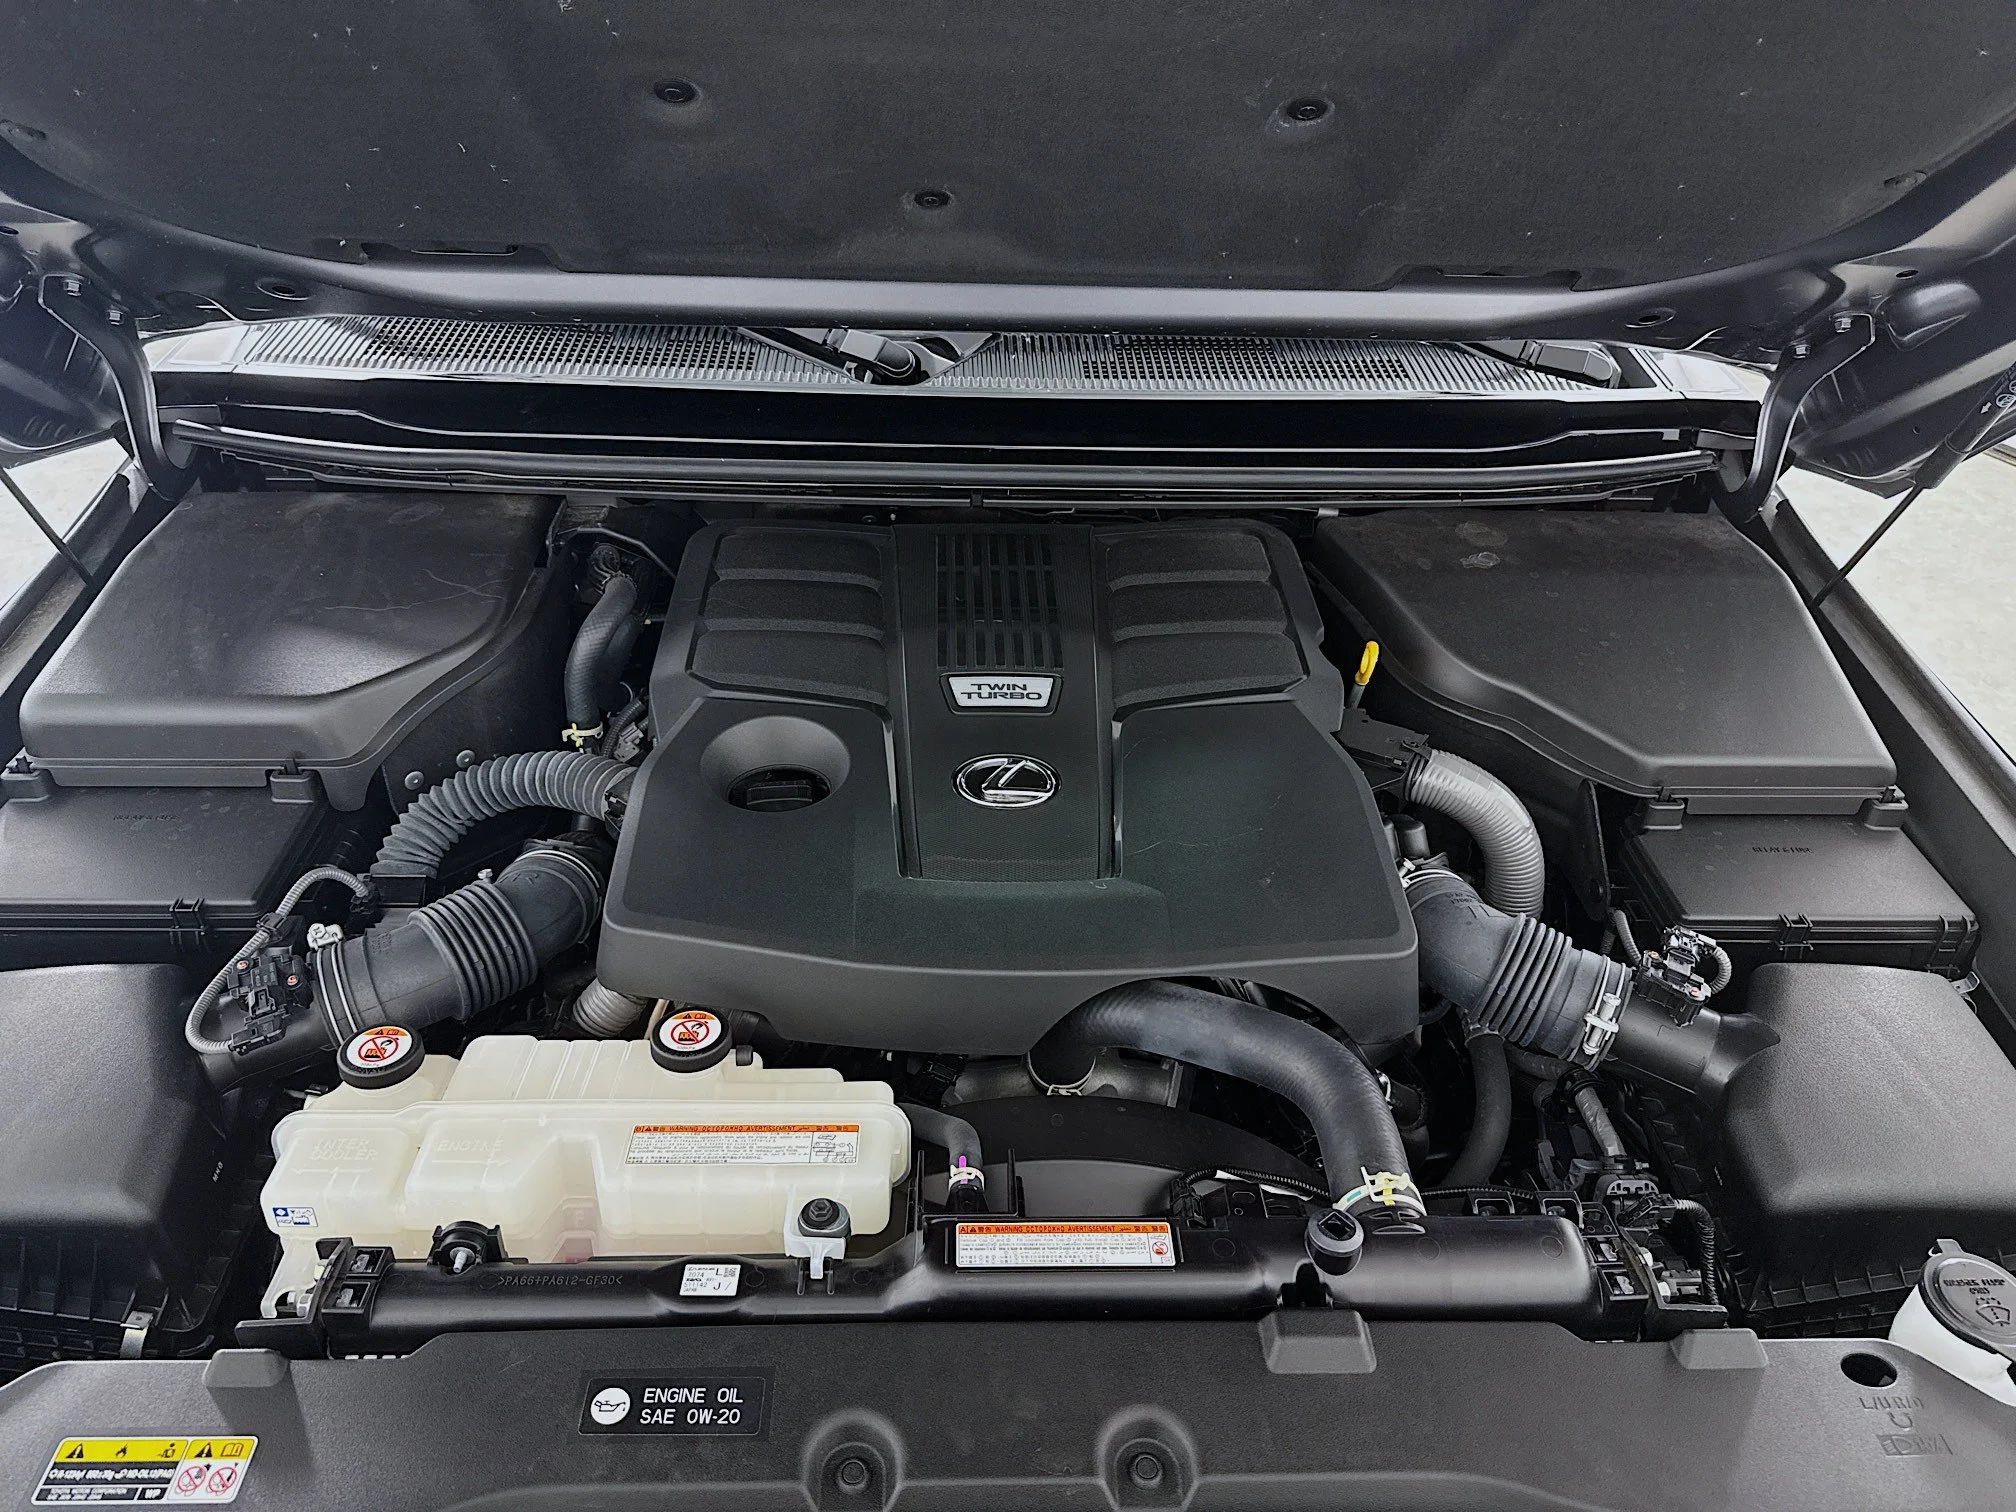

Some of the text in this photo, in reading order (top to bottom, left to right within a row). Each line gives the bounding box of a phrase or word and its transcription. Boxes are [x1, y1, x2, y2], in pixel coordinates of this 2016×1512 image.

[961, 692, 1042, 700] TURBO
[498, 1276, 622, 1285] >PA66+PA612-GF30<
[643, 1388, 743, 1403] ENGINE OIL
[640, 1409, 741, 1424] SAE 0W-20
